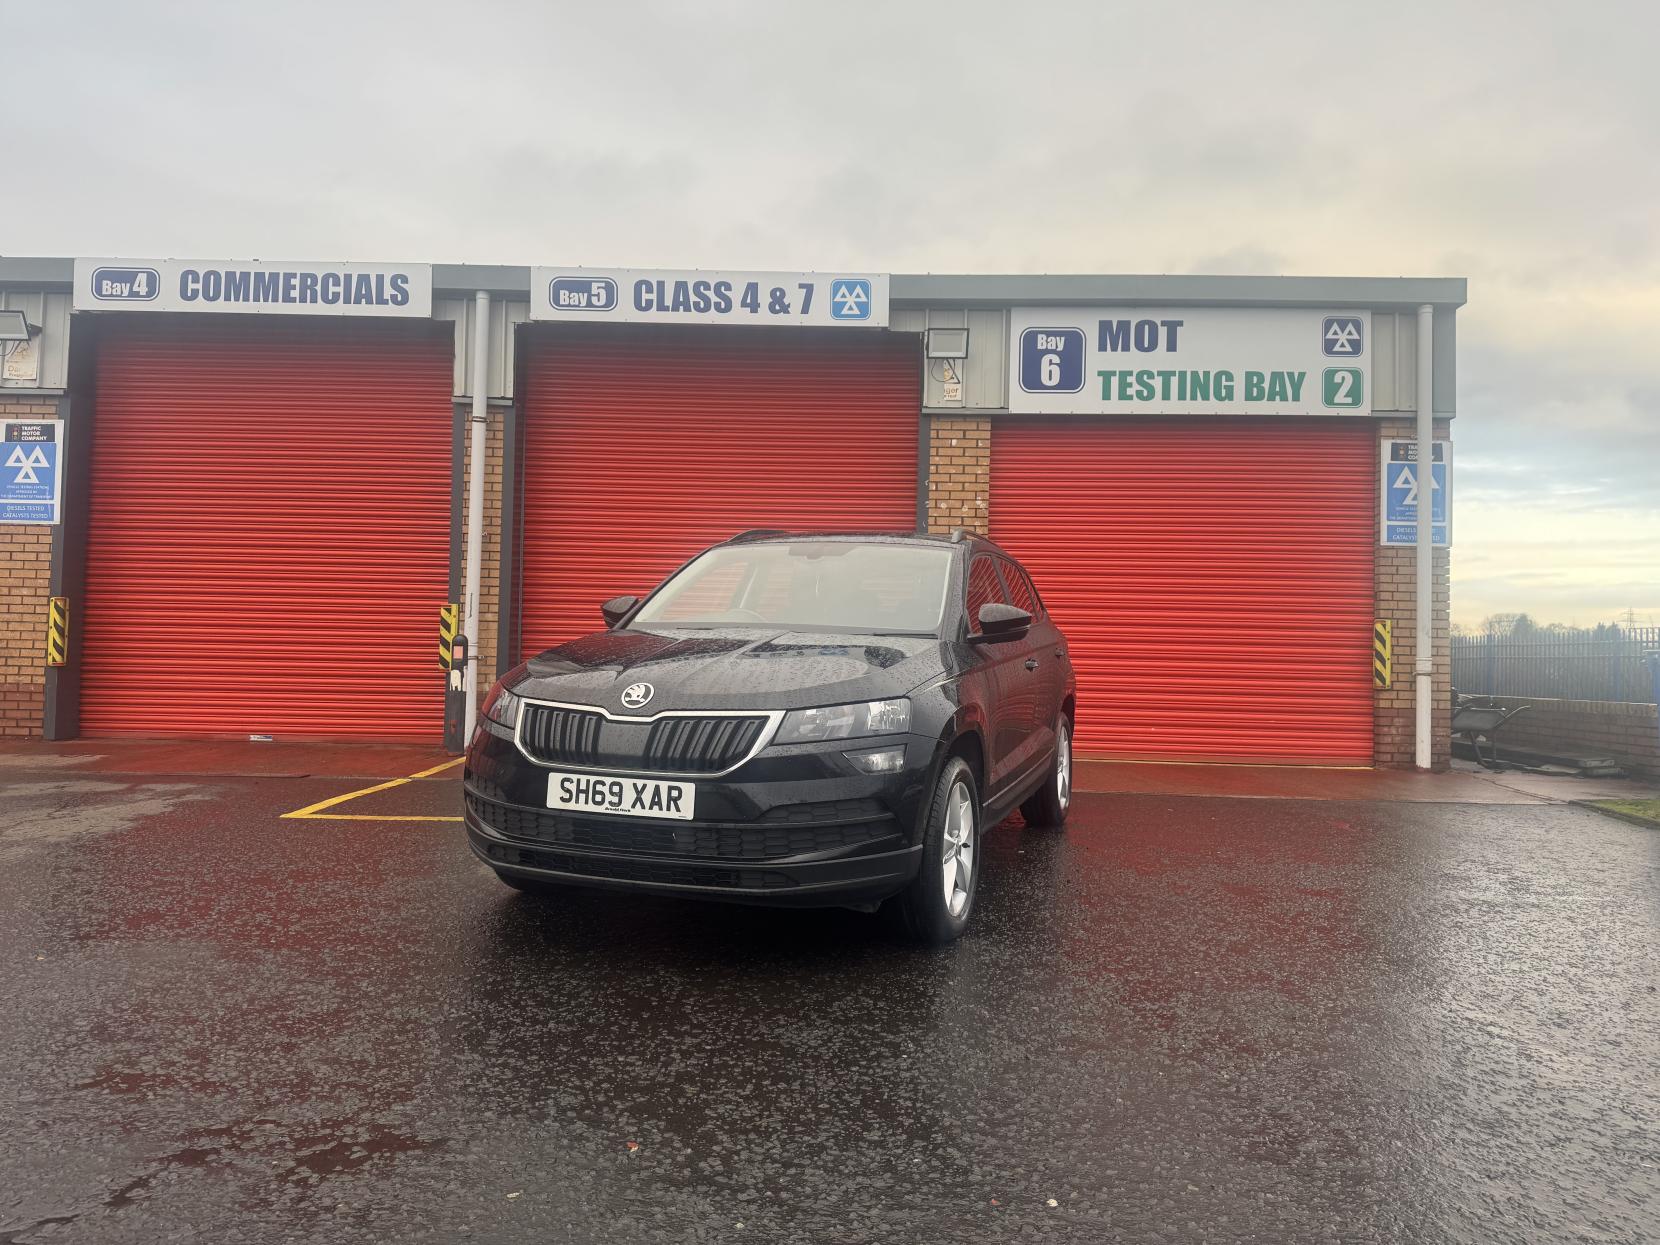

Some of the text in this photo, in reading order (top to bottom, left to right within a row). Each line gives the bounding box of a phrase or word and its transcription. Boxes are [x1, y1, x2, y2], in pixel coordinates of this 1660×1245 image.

[102, 272, 149, 298] Bay 4
[180, 269, 409, 306] COMMERCIALS
[559, 282, 607, 308] Bay 5
[633, 279, 815, 315] CLASS 4 & 7
[1037, 333, 1065, 352] Bay
[1098, 319, 1184, 353] MOT
[1040, 354, 1061, 387] 6
[1097, 369, 1307, 403] TESTING BAY
[1333, 370, 1353, 404] 2
[559, 776, 683, 813] SH69 XAR
